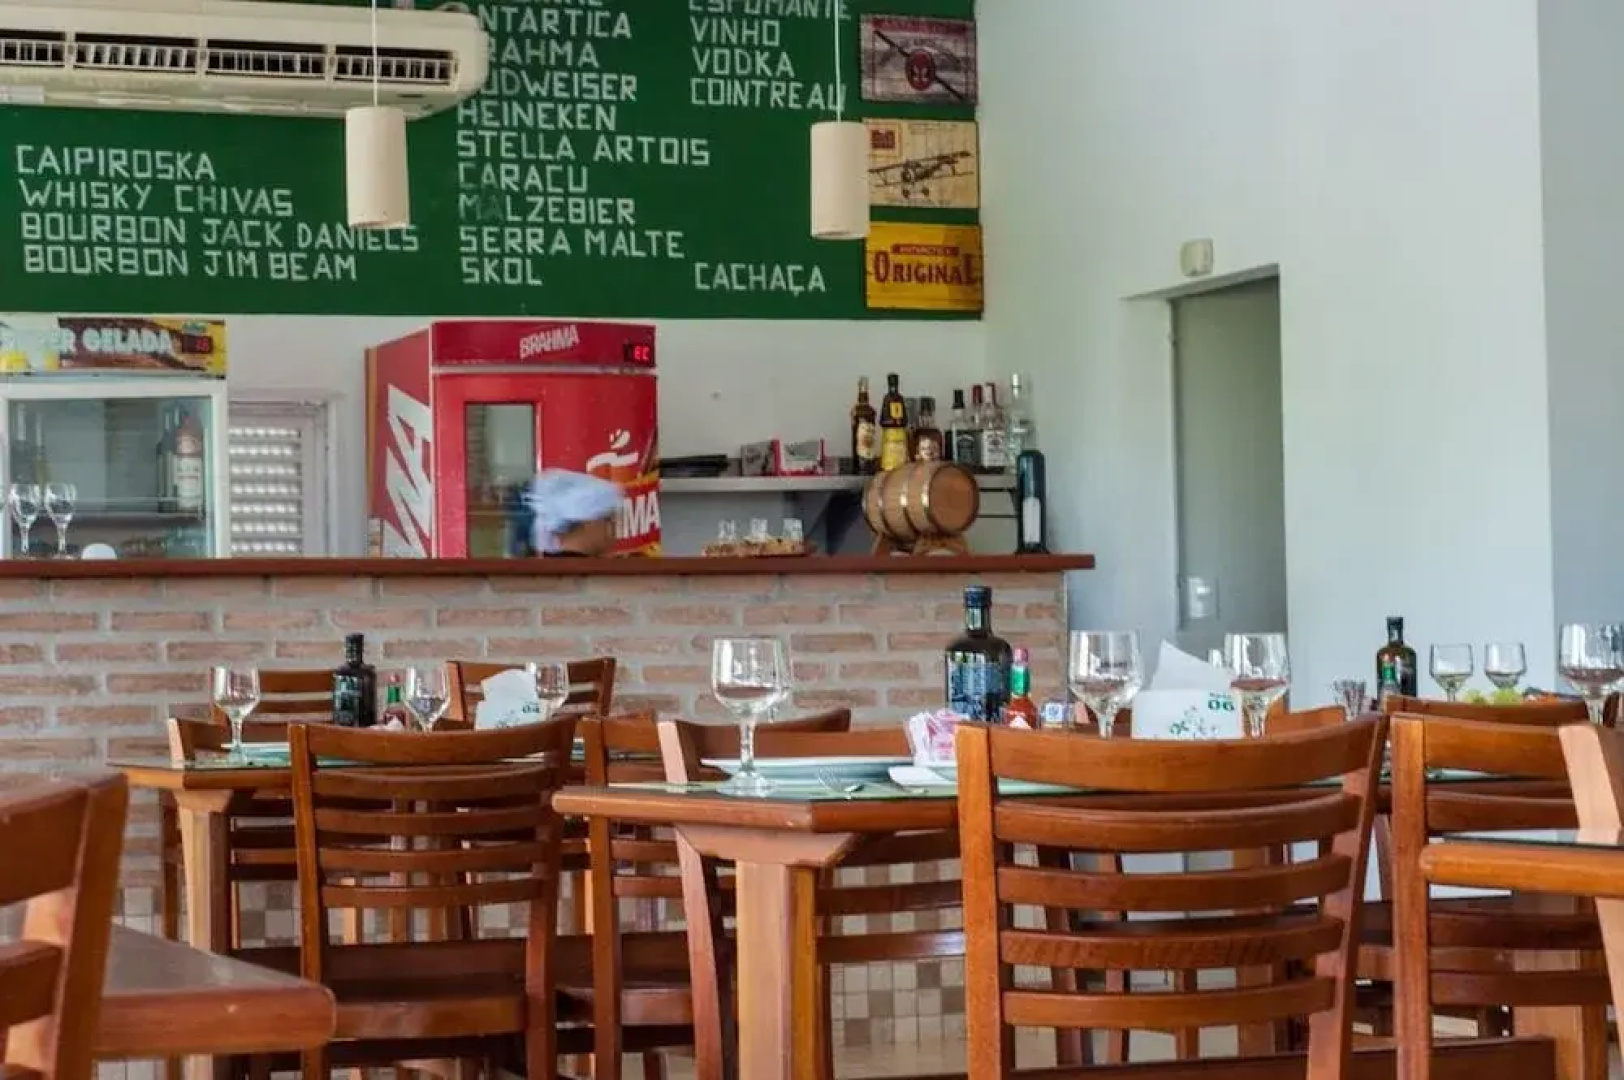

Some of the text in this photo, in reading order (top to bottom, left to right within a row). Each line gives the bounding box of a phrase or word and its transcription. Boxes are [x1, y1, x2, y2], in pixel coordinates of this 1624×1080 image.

[478, 4, 633, 39] NTARTICA
[691, 17, 780, 46] VINHO
[488, 36, 600, 68] AHMA
[692, 47, 795, 78] VODKA
[480, 67, 637, 100] UDWEISER
[690, 77, 846, 112] COINTREAU
[457, 100, 616, 130] HEINEKEN
[17, 145, 216, 181] CAIPIROSKA
[457, 129, 709, 165] STELLA ARTOIS
[458, 161, 589, 194] CARACU
[18, 178, 293, 217] WHISKY CHIVAS
[21, 212, 419, 251] BOURBON JACK DANIELS
[460, 226, 684, 258] SERRA MALTE
[23, 244, 357, 281] BOURBON JIM BEAM
[461, 256, 542, 285] SKOL
[694, 262, 826, 295] CACHAÇA
[519, 324, 580, 360] BRAHMA
[616, 491, 661, 540] MA
